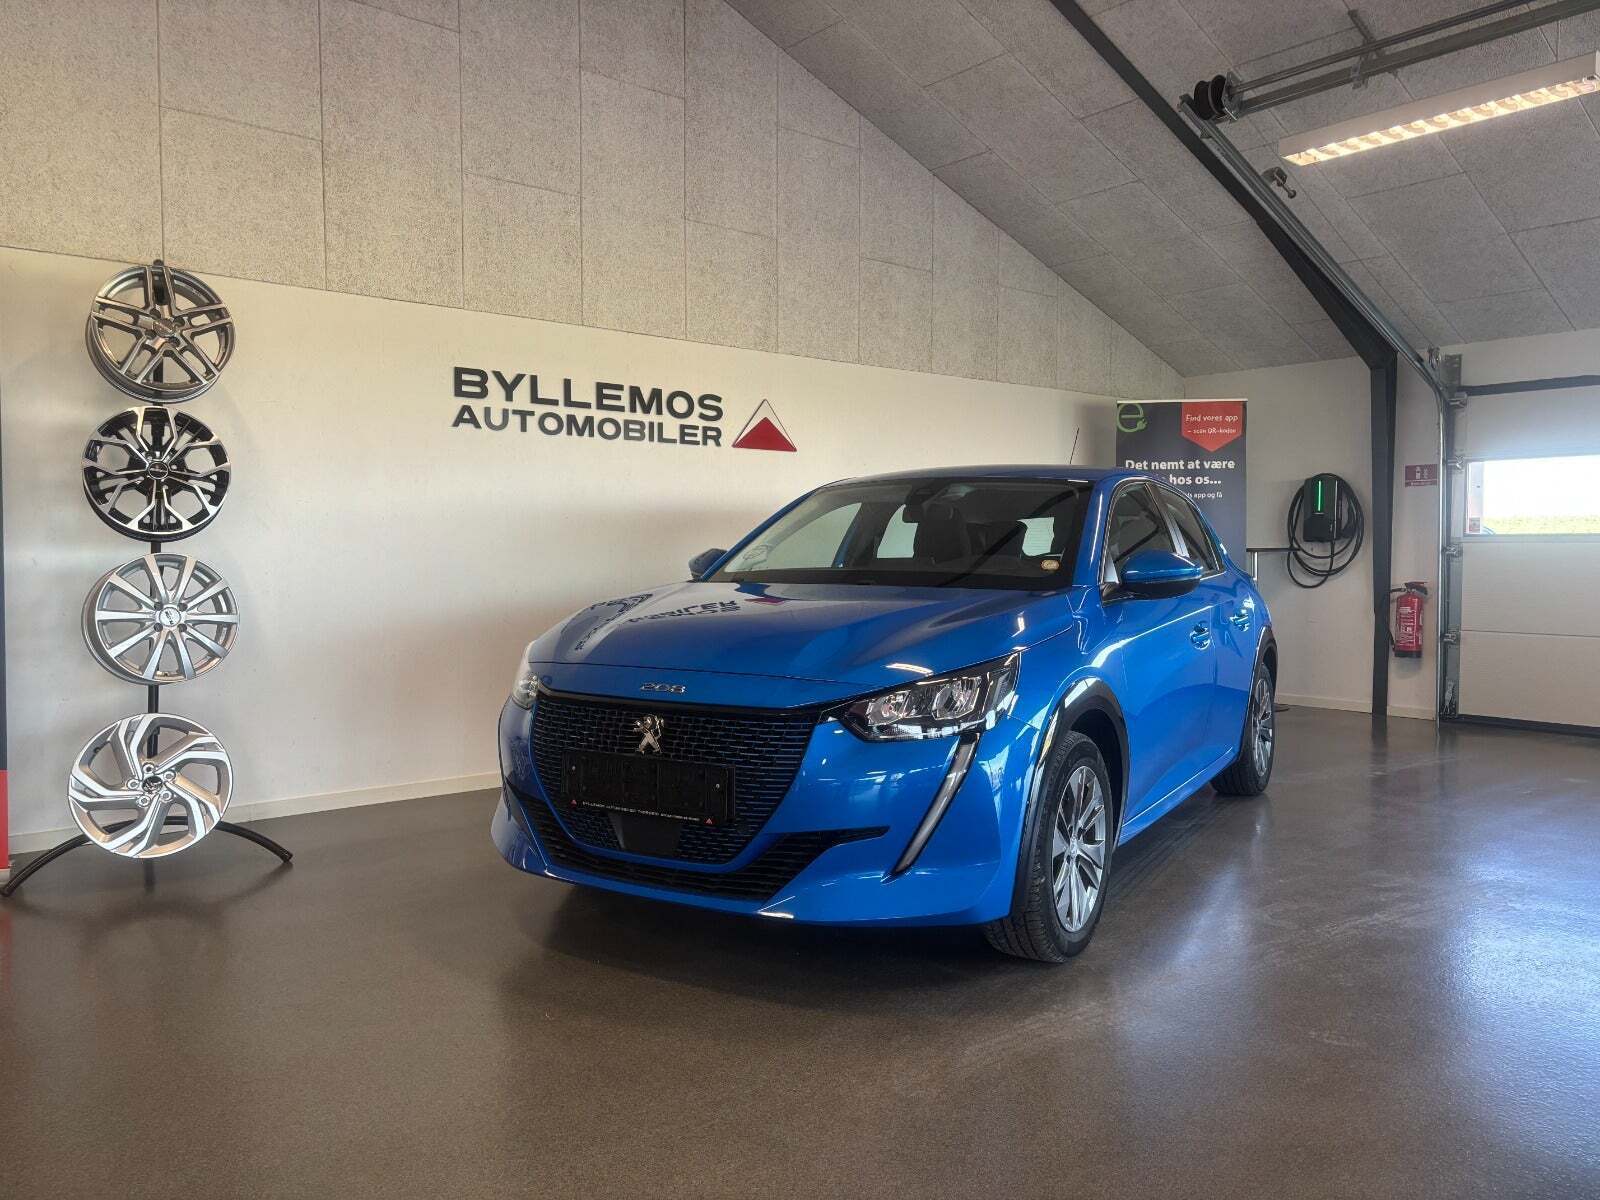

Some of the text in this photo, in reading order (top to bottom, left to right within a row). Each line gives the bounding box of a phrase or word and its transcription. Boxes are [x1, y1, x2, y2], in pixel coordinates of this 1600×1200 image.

[454, 366, 724, 422] BYLLEMOS
[1185, 414, 1202, 422] Find
[1225, 415, 1239, 423] app
[452, 404, 723, 447] AUTOMOBILER
[1125, 459, 1236, 470] Det nemt at være
[1169, 474, 1192, 485] hos
[640, 682, 687, 694] 208
